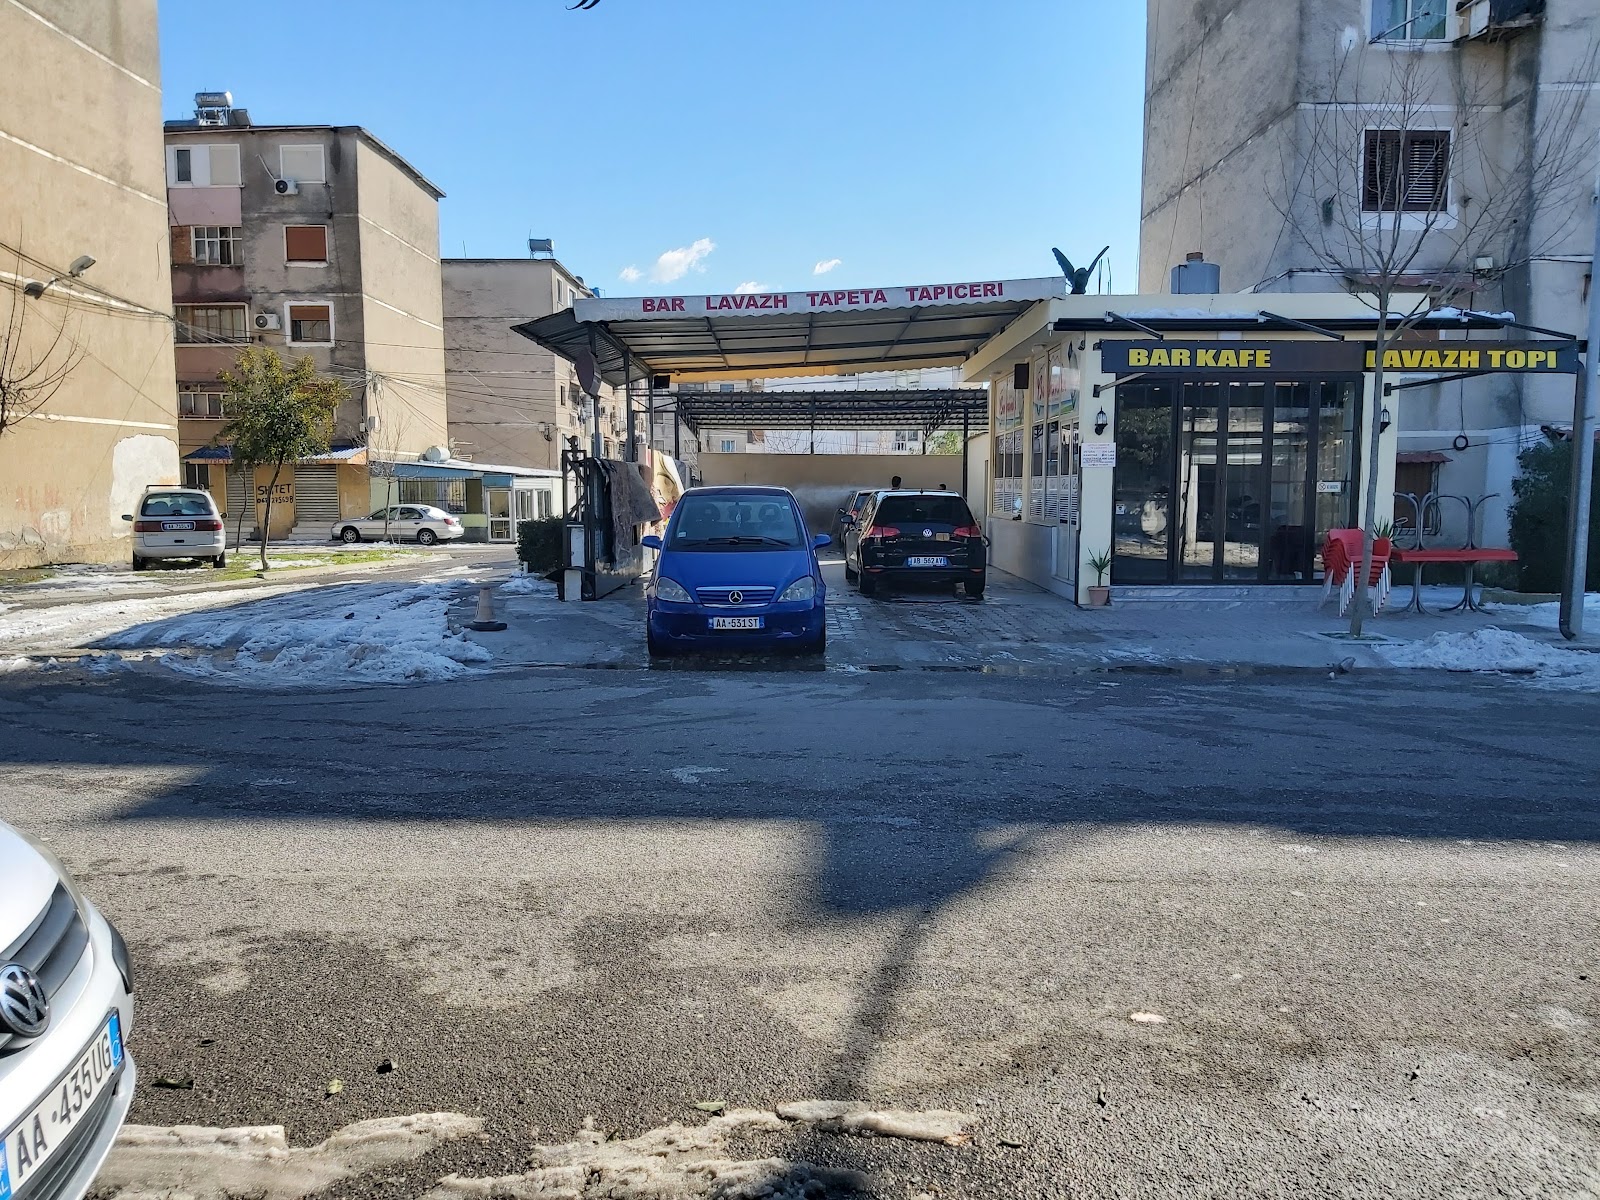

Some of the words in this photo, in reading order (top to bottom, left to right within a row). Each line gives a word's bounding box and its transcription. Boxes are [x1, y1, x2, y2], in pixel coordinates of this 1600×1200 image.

[642, 298, 685, 312] BAR
[705, 295, 788, 310] LAVAZH
[806, 289, 888, 307] TAPETA
[905, 282, 1004, 302] TAPICERI
[1128, 349, 1191, 367] BAR
[1196, 349, 1272, 368] KAFE
[1365, 350, 1480, 368] LAVAZH
[1487, 350, 1557, 369] TOPI
[257, 483, 291, 495] SHTET
